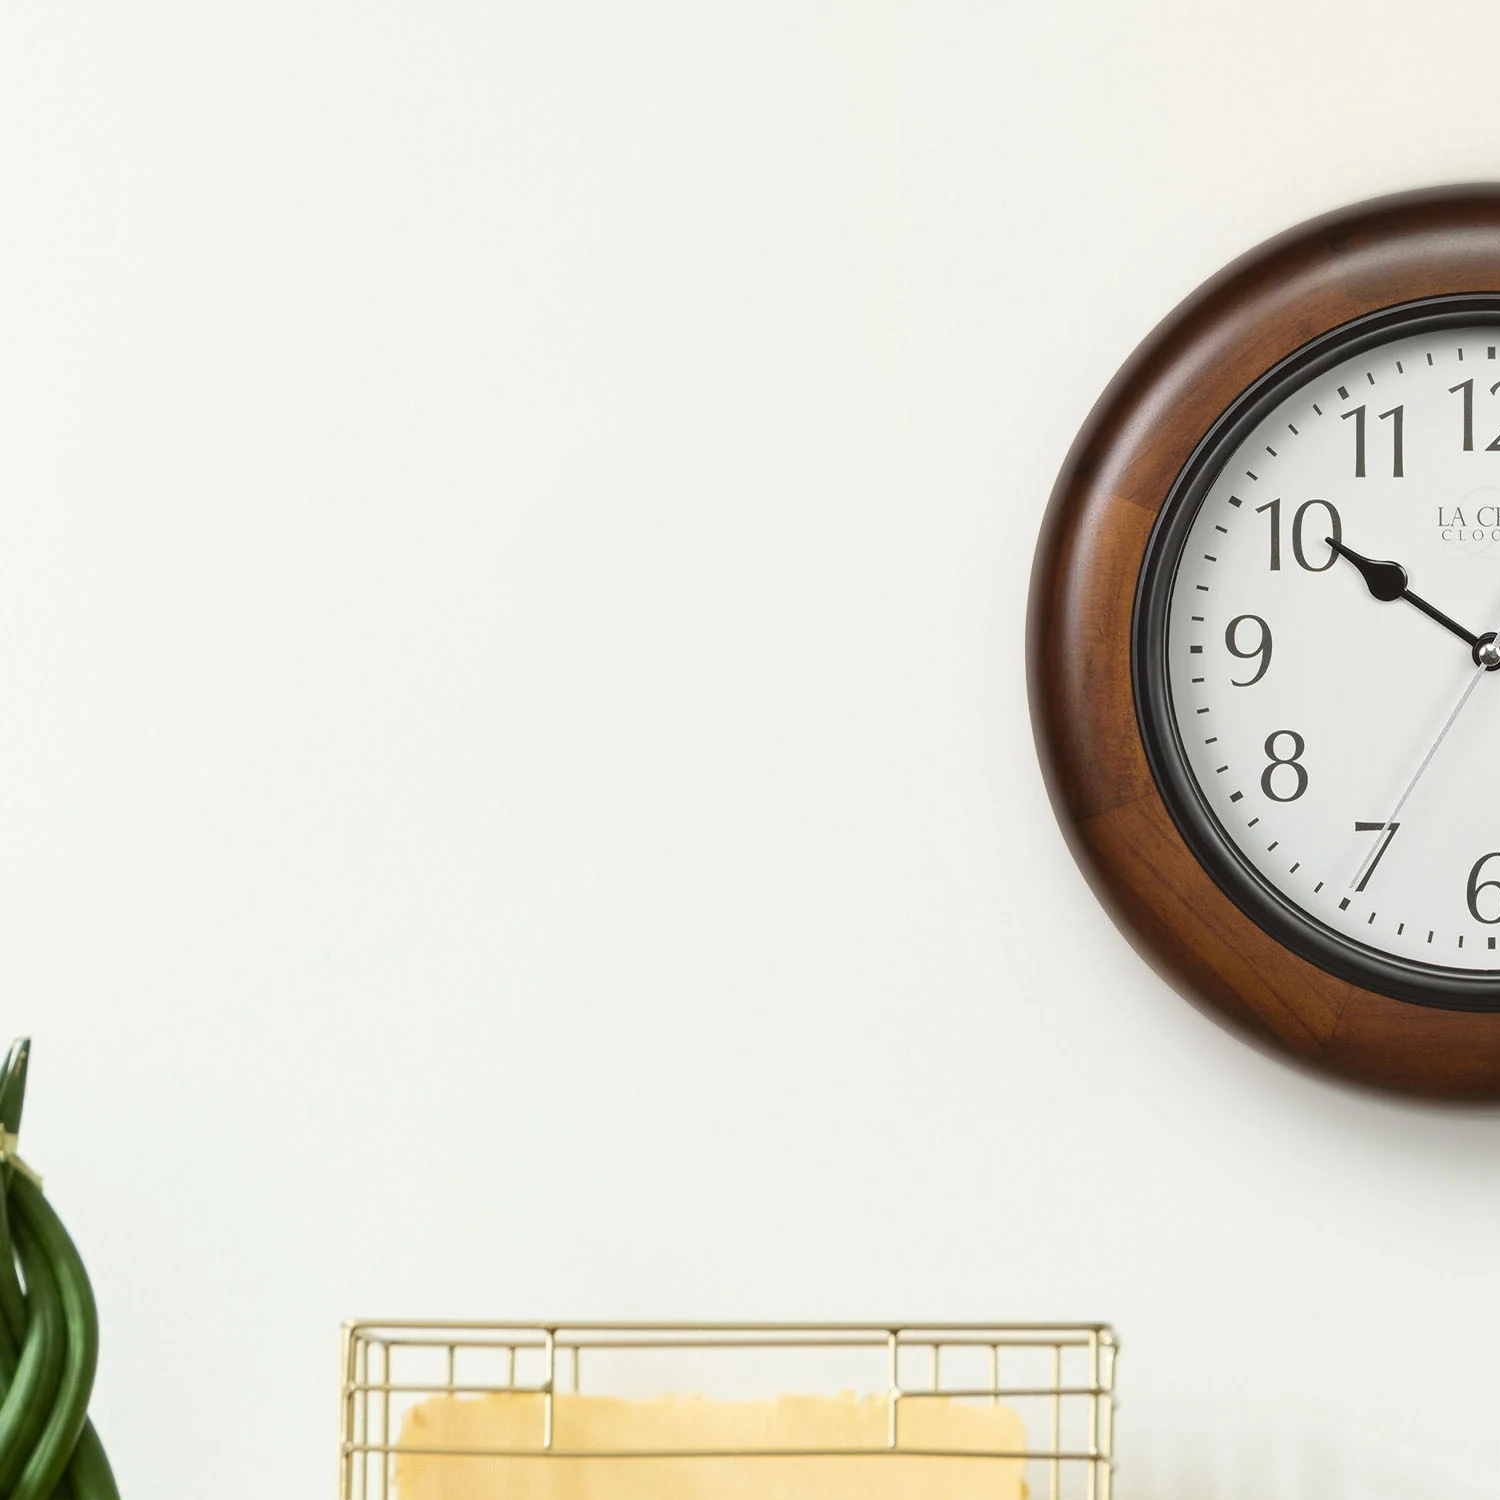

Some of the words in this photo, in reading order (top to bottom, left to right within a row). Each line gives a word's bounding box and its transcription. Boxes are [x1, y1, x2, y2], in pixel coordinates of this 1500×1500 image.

[1340, 404, 1404, 478] 11
[1255, 497, 1343, 573] 10
[1438, 506, 1467, 527] LA
[1224, 614, 1273, 687] 9
[1260, 729, 1309, 803] 8
[1354, 821, 1401, 893] 7
